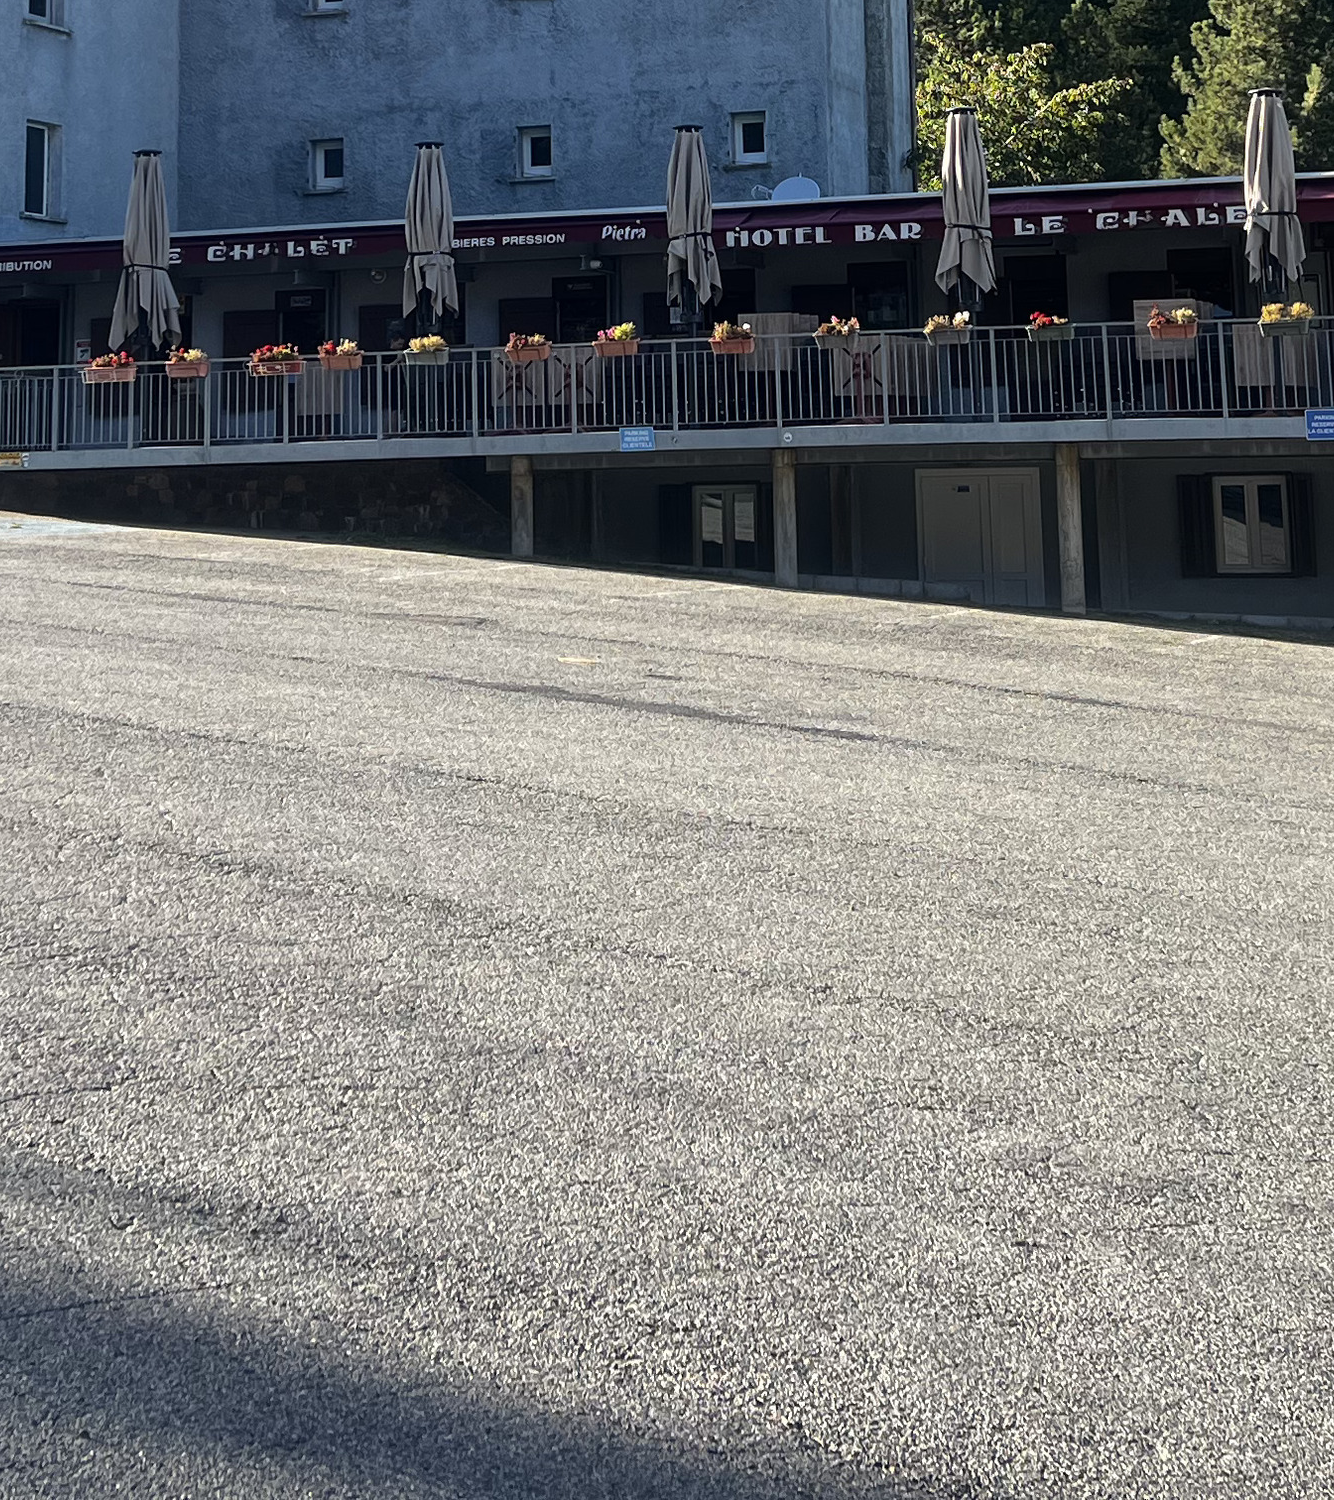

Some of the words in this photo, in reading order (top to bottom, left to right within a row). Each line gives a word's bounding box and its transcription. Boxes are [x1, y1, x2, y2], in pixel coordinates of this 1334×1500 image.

[601, 224, 647, 241] Pietra
[725, 227, 833, 248] HOTEL
[854, 222, 922, 243] BAR
[1013, 215, 1065, 236] LE
[452, 236, 496, 249] BIERES
[501, 233, 566, 247] PRESSION
